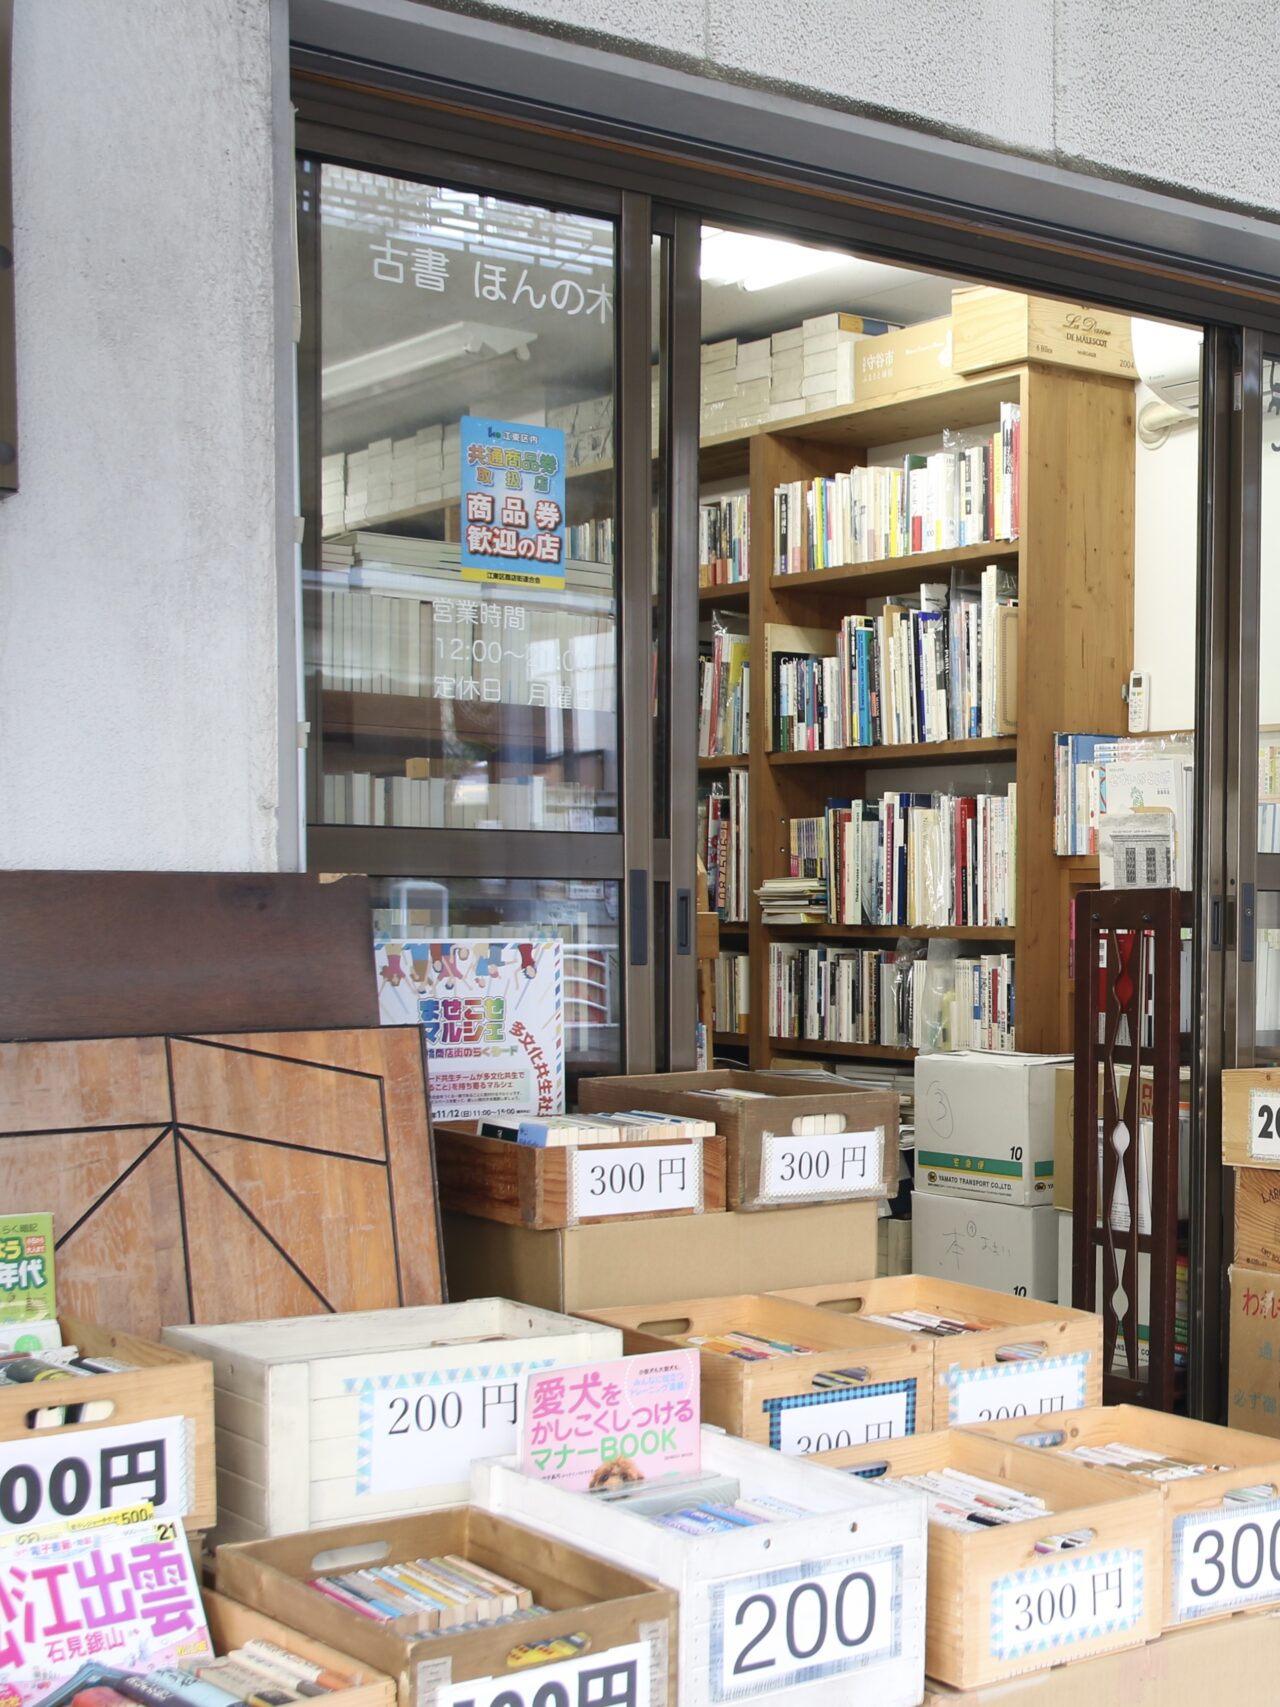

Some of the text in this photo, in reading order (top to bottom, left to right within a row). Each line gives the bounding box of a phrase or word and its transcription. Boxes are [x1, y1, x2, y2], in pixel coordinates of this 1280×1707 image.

[369, 240, 613, 324] 古書 ほんの木
[467, 444, 558, 475] 共通商品券
[467, 493, 561, 529] 商品券
[467, 525, 561, 563] 歓迎の店
[432, 599, 525, 631] 営業時間
[434, 676, 501, 702] 定休日
[509, 1021, 553, 1117] 多文化共生社
[780, 1144, 868, 1182] 300円
[952, 1157, 985, 1170] 宅急便
[1010, 1146, 1023, 1161] 10
[589, 1156, 687, 1196] 300円
[938, 1174, 958, 1184] YAMATO
[959, 1178, 989, 1188] TRANSPORT
[0, 1223, 38, 1235] らく暗記
[1013, 1286, 1027, 1297] 10
[388, 1382, 519, 1436] 200円
[532, 1371, 622, 1419] 愛犬を
[531, 1398, 694, 1445] かしこくしつける
[530, 1427, 677, 1471] マナーBOOK
[1014, 1566, 1124, 1633] 300円
[732, 1571, 878, 1675] 200
[45, 1627, 125, 1663] 石見銀山
